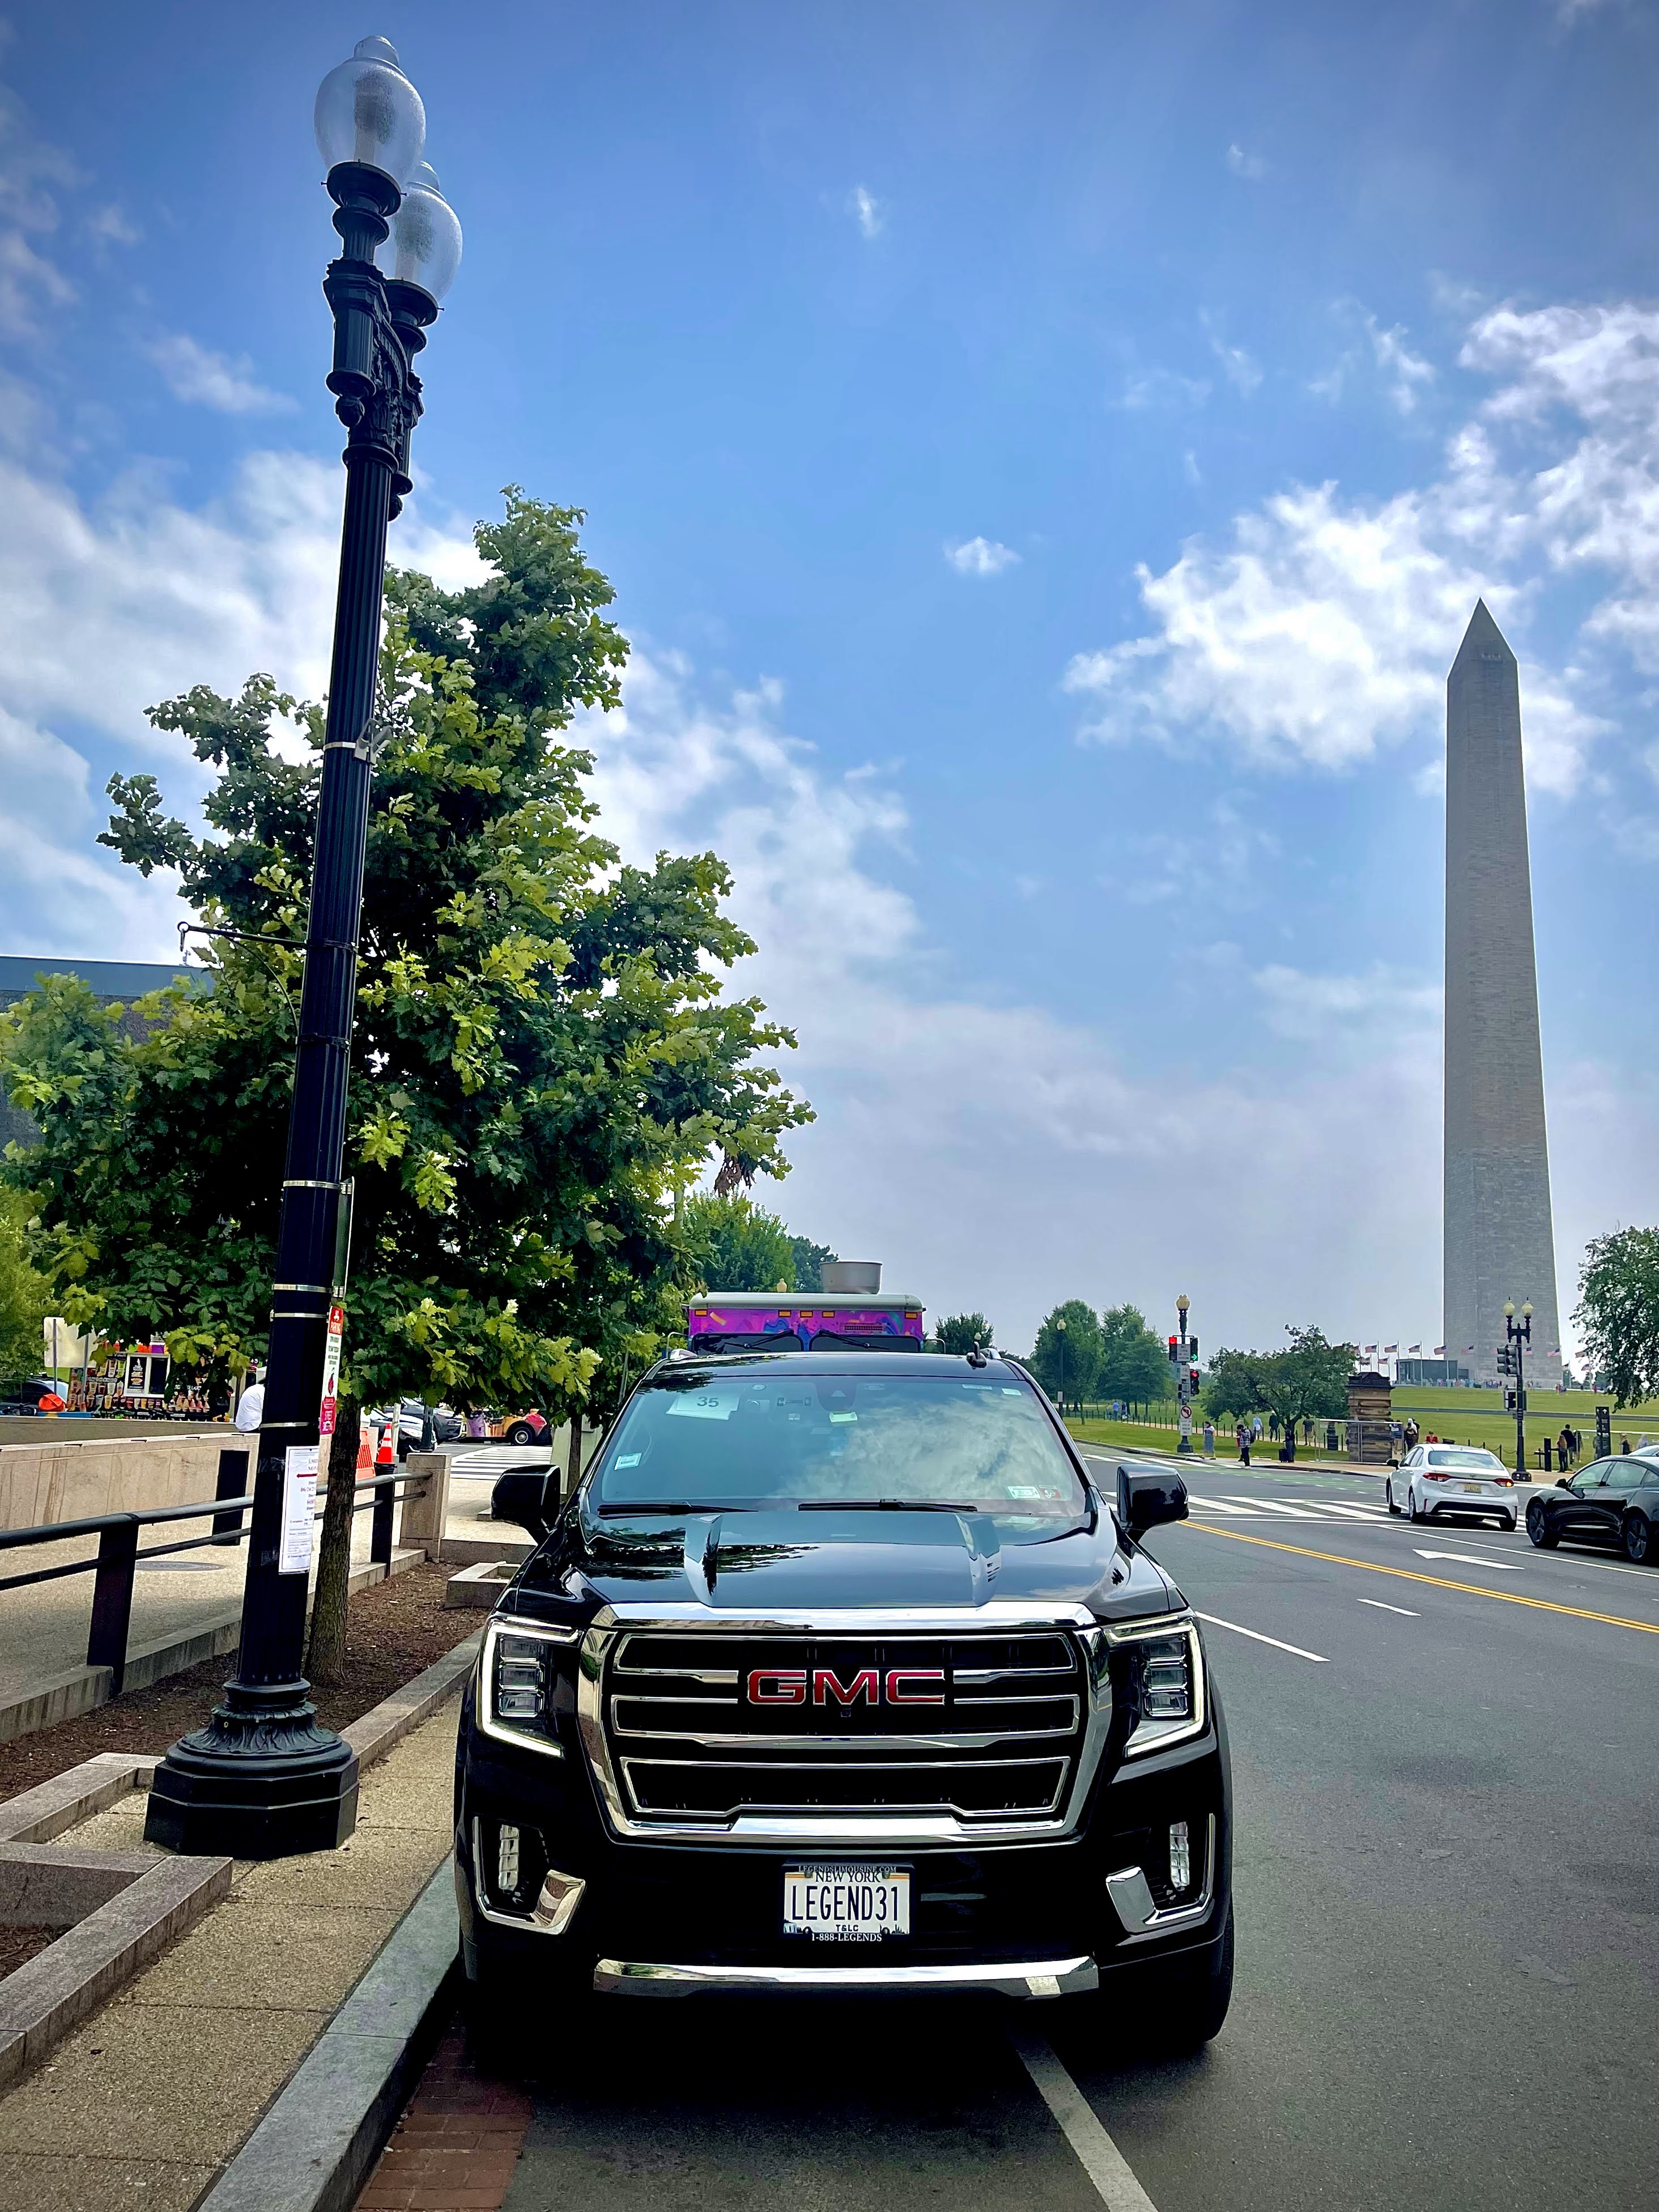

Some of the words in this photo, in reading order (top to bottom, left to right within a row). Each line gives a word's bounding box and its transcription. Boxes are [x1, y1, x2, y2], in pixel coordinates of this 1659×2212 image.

[697, 1396, 719, 1407] 35
[747, 1669, 945, 1705] GMC
[815, 1872, 845, 1882] NEW
[847, 1871, 881, 1882] YORK
[792, 1885, 898, 1921] LEGEND31
[811, 1933, 882, 1942] 1-888-LEGENDS
